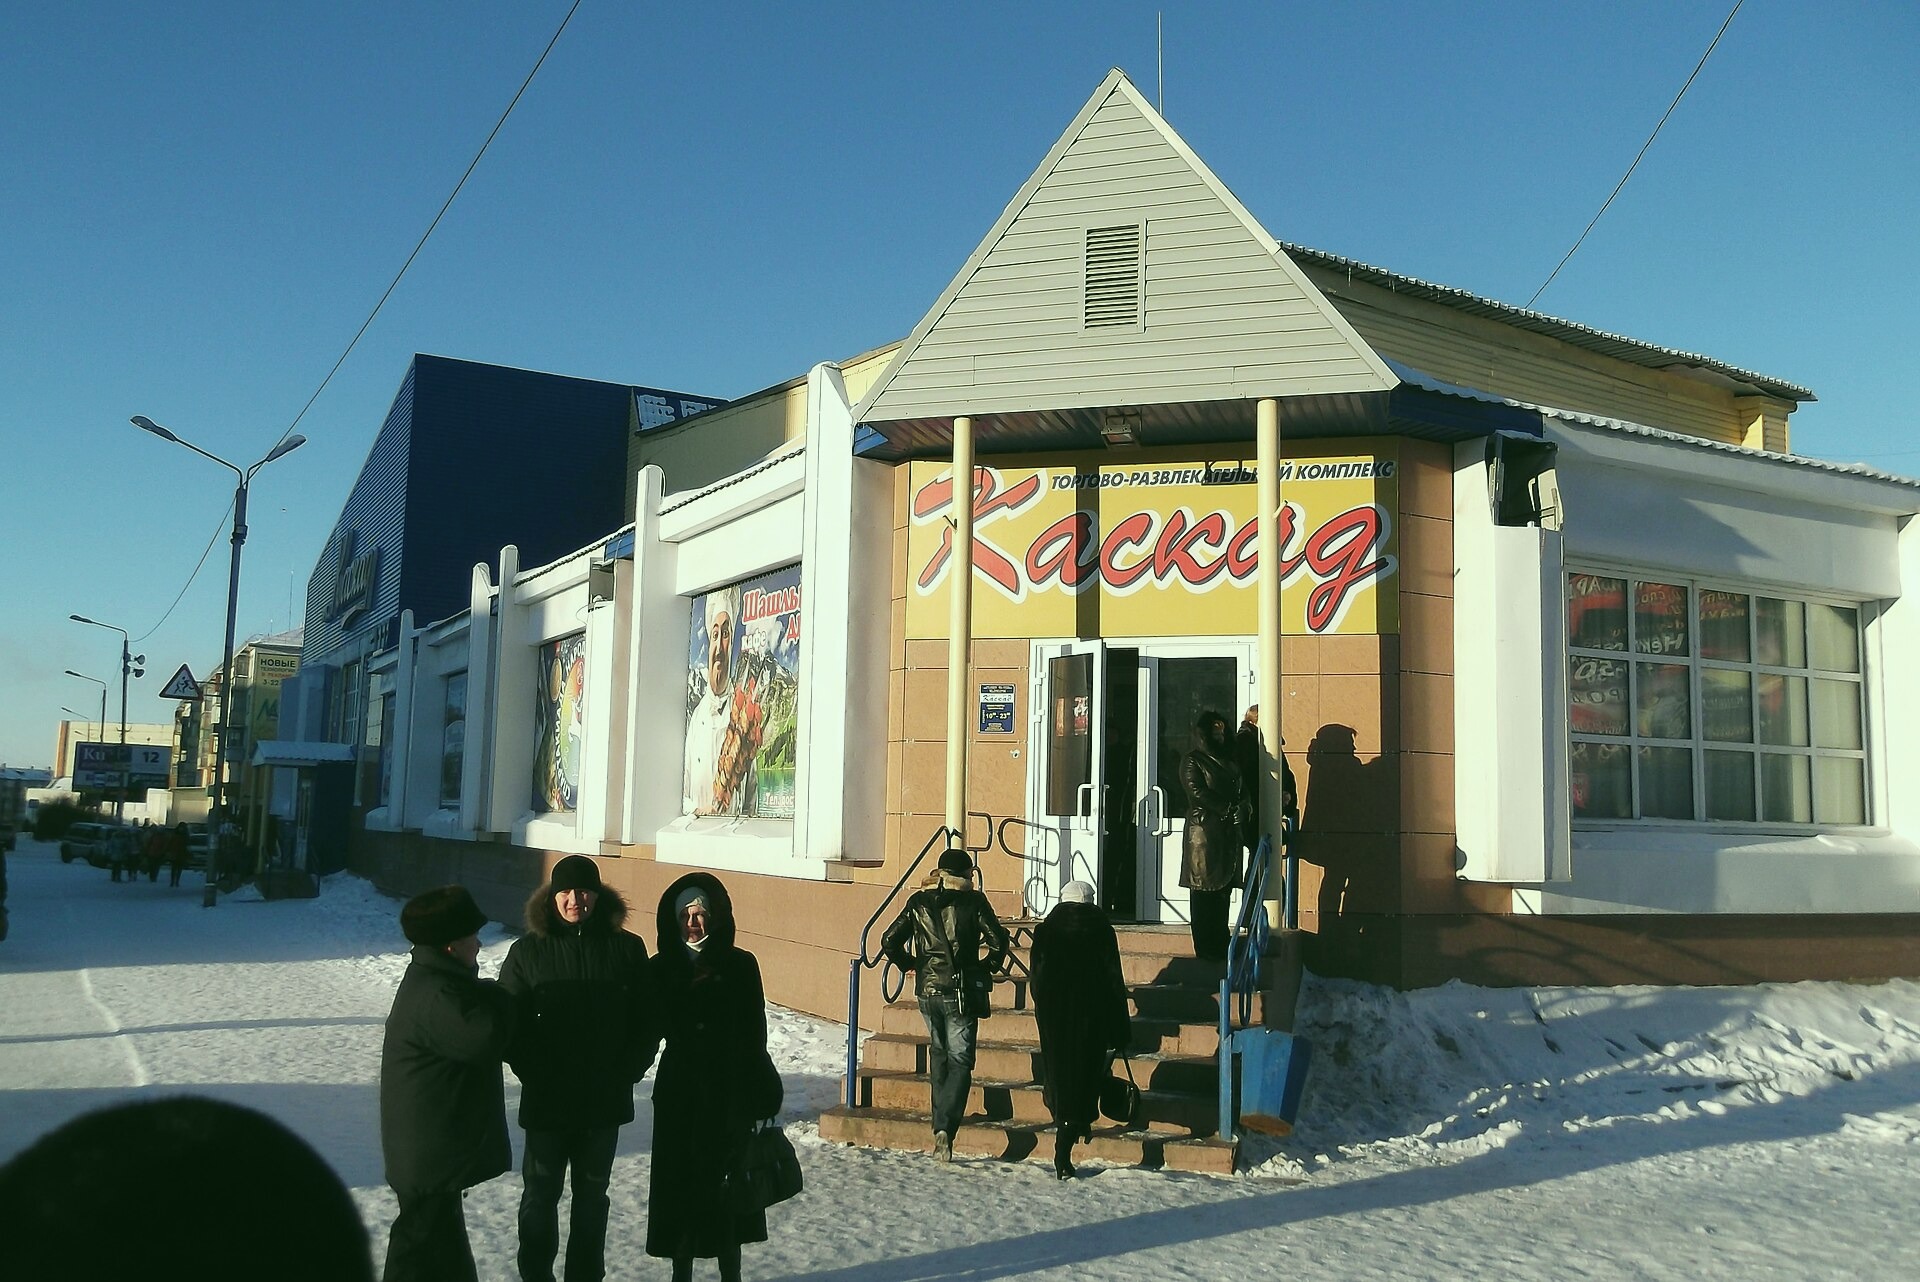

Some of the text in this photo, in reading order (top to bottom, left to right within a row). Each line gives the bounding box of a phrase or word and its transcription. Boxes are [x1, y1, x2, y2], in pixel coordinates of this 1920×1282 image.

[1052, 461, 1394, 489] ТОРГОВО-РАЗВЛЕКАТЕЛЬЙ КОМПЛЕКС
[914, 465, 1388, 632] Каскад
[260, 658, 297, 668] НОВЫЕ
[142, 751, 160, 763] 12
